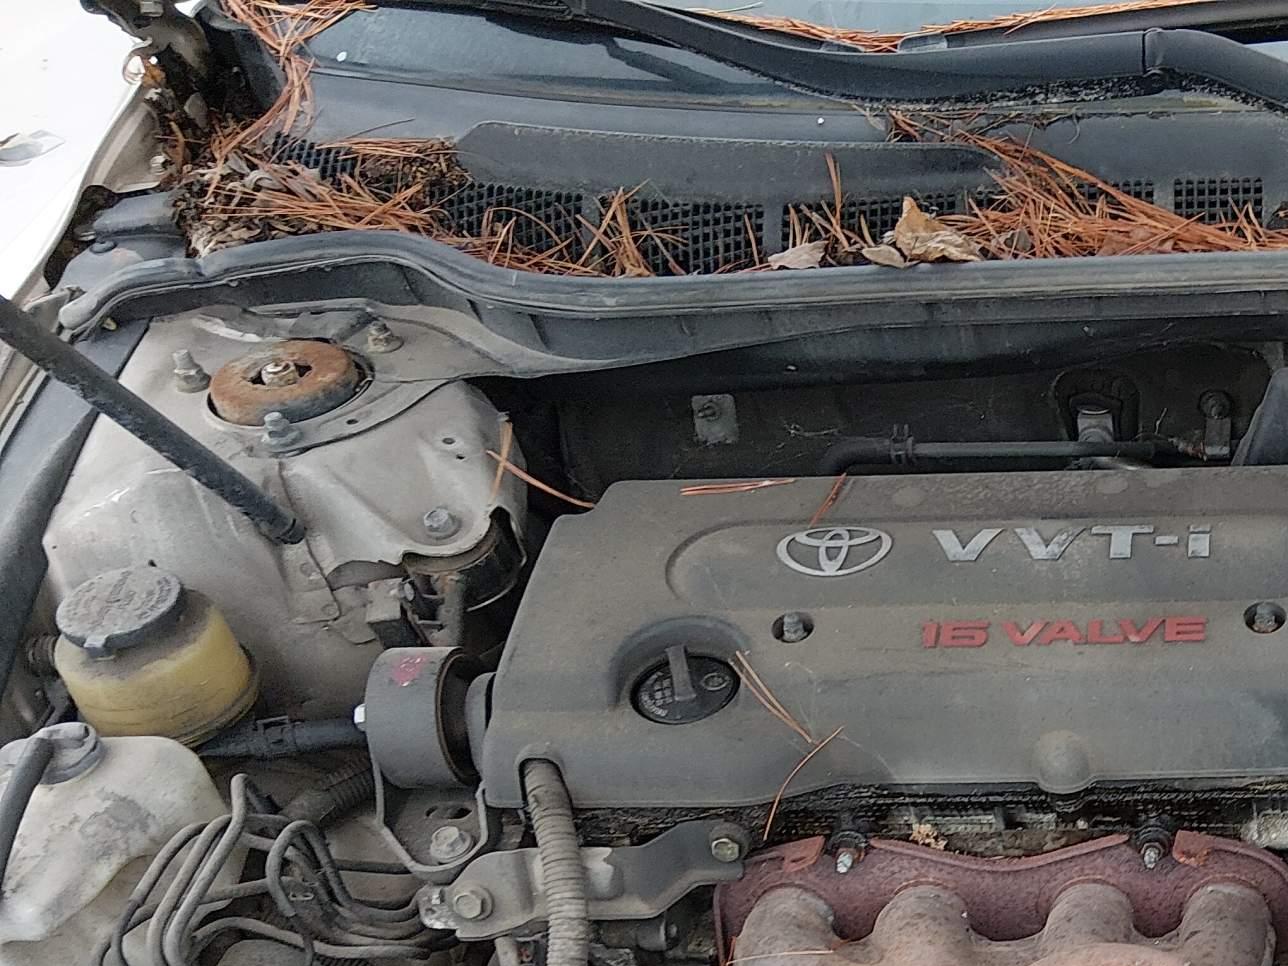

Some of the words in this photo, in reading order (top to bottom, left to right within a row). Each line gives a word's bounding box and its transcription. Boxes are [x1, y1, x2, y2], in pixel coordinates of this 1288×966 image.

[932, 525, 1213, 562] VVT-i
[921, 618, 989, 649] 16
[1003, 616, 1209, 645] VALVE
